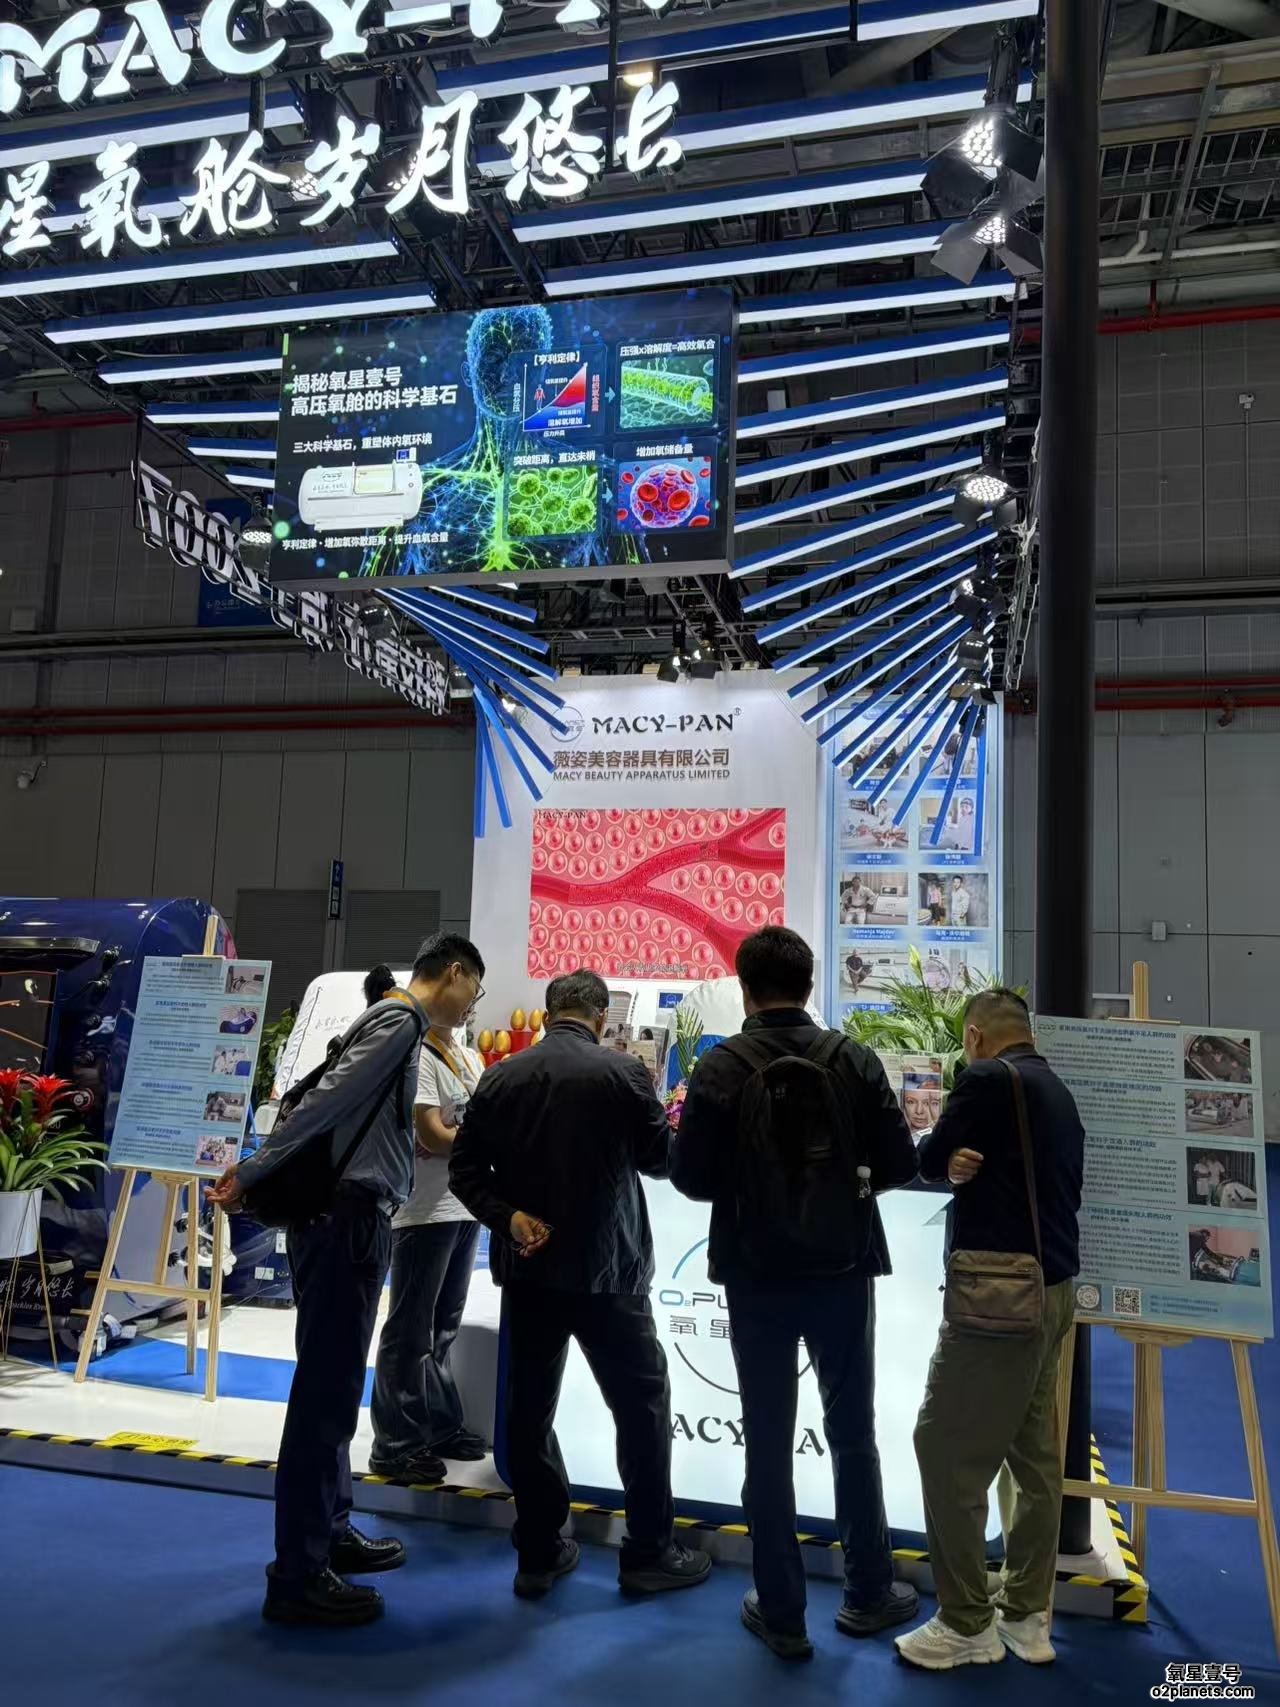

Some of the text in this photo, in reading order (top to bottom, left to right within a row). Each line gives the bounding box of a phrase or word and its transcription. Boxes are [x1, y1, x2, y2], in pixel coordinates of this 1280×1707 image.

[0, 0, 668, 113] MACY-
[292, 366, 402, 394] 揭秘氧星壹号
[291, 384, 458, 417] 高压氧舱的科学基石
[592, 714, 733, 734] MACY-PAN
[553, 748, 729, 768] 薇姿美容器具有限公司
[553, 769, 730, 781] MACY BEAUTY APPARATUS LIMITED
[669, 1315, 731, 1339] 氧星
